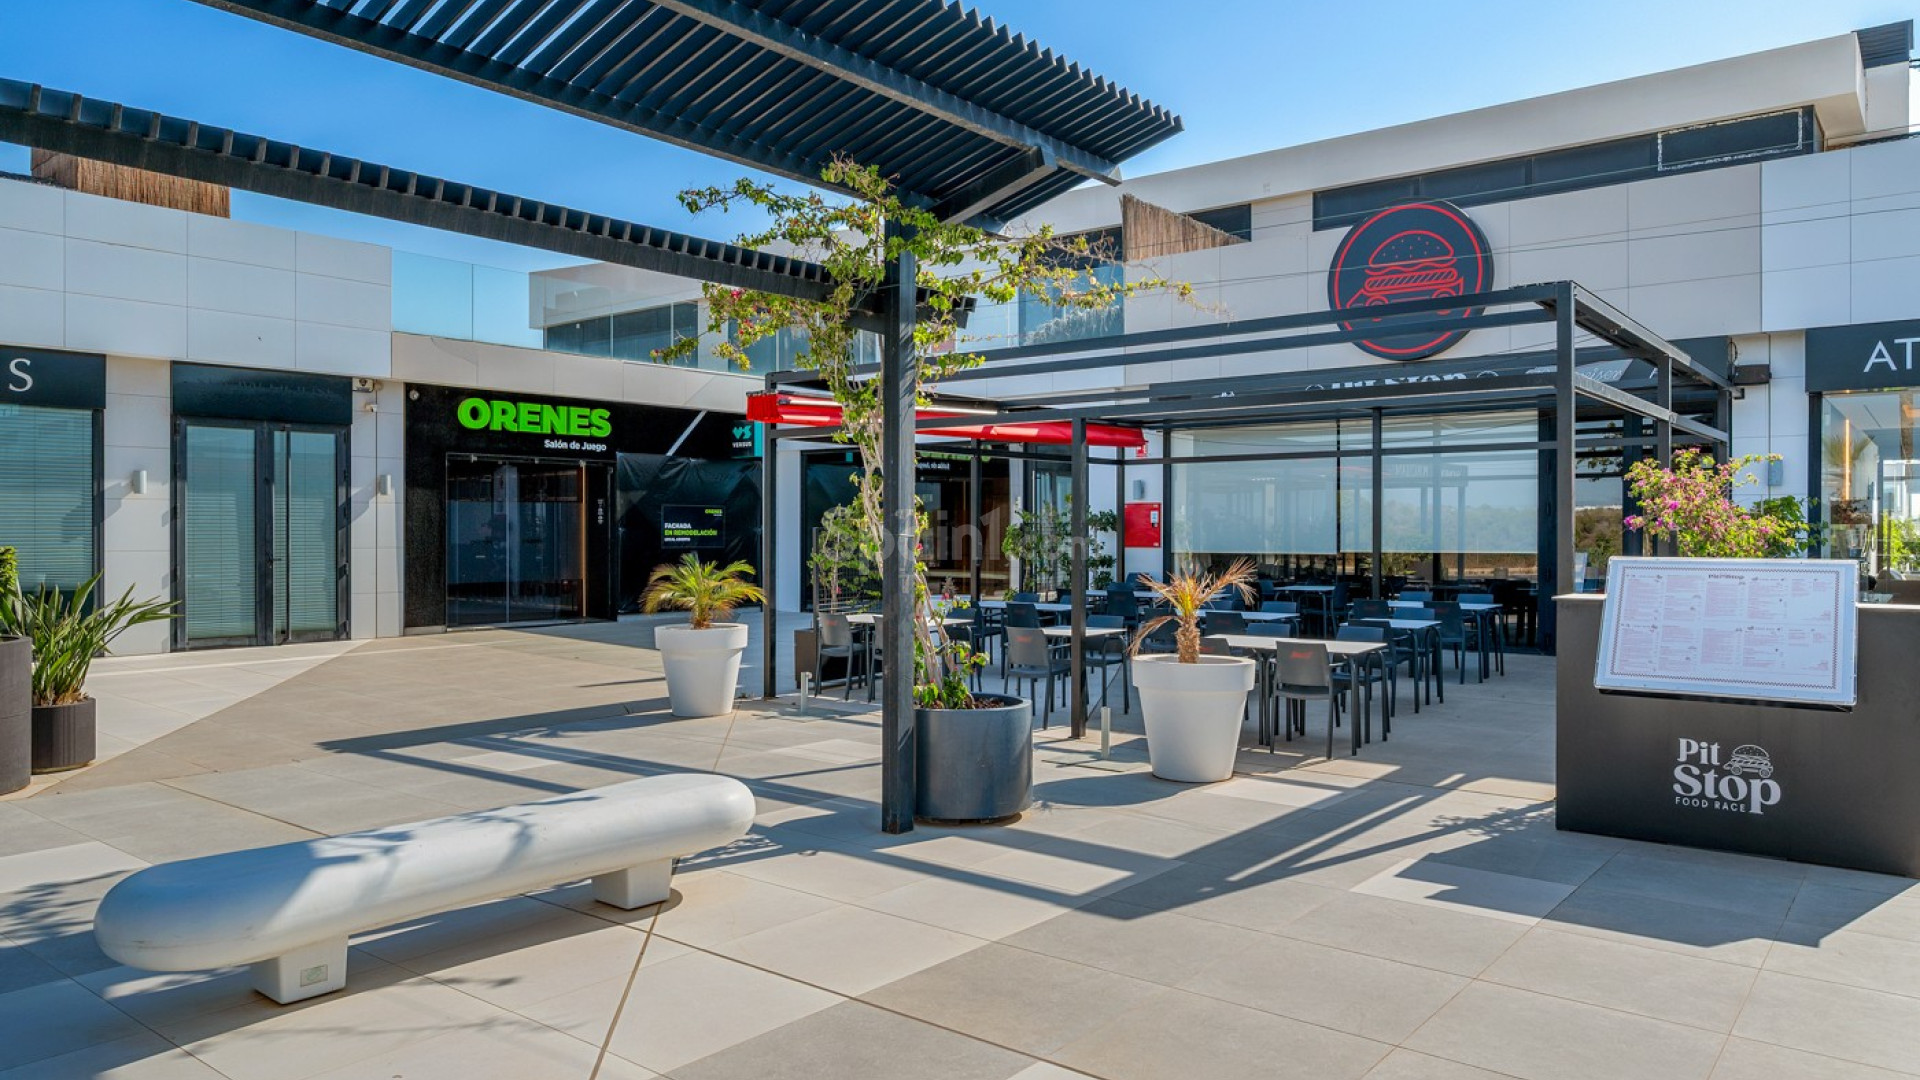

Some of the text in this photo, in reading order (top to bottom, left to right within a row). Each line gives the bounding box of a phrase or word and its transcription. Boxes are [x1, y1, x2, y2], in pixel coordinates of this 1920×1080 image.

[9, 358, 33, 392] S
[457, 397, 612, 438] ORENES
[544, 439, 607, 452] Salón de Juego
[1677, 737, 1720, 766] Pit
[1672, 764, 1781, 815] Stop
[1675, 796, 1746, 813] FOOD RACE
